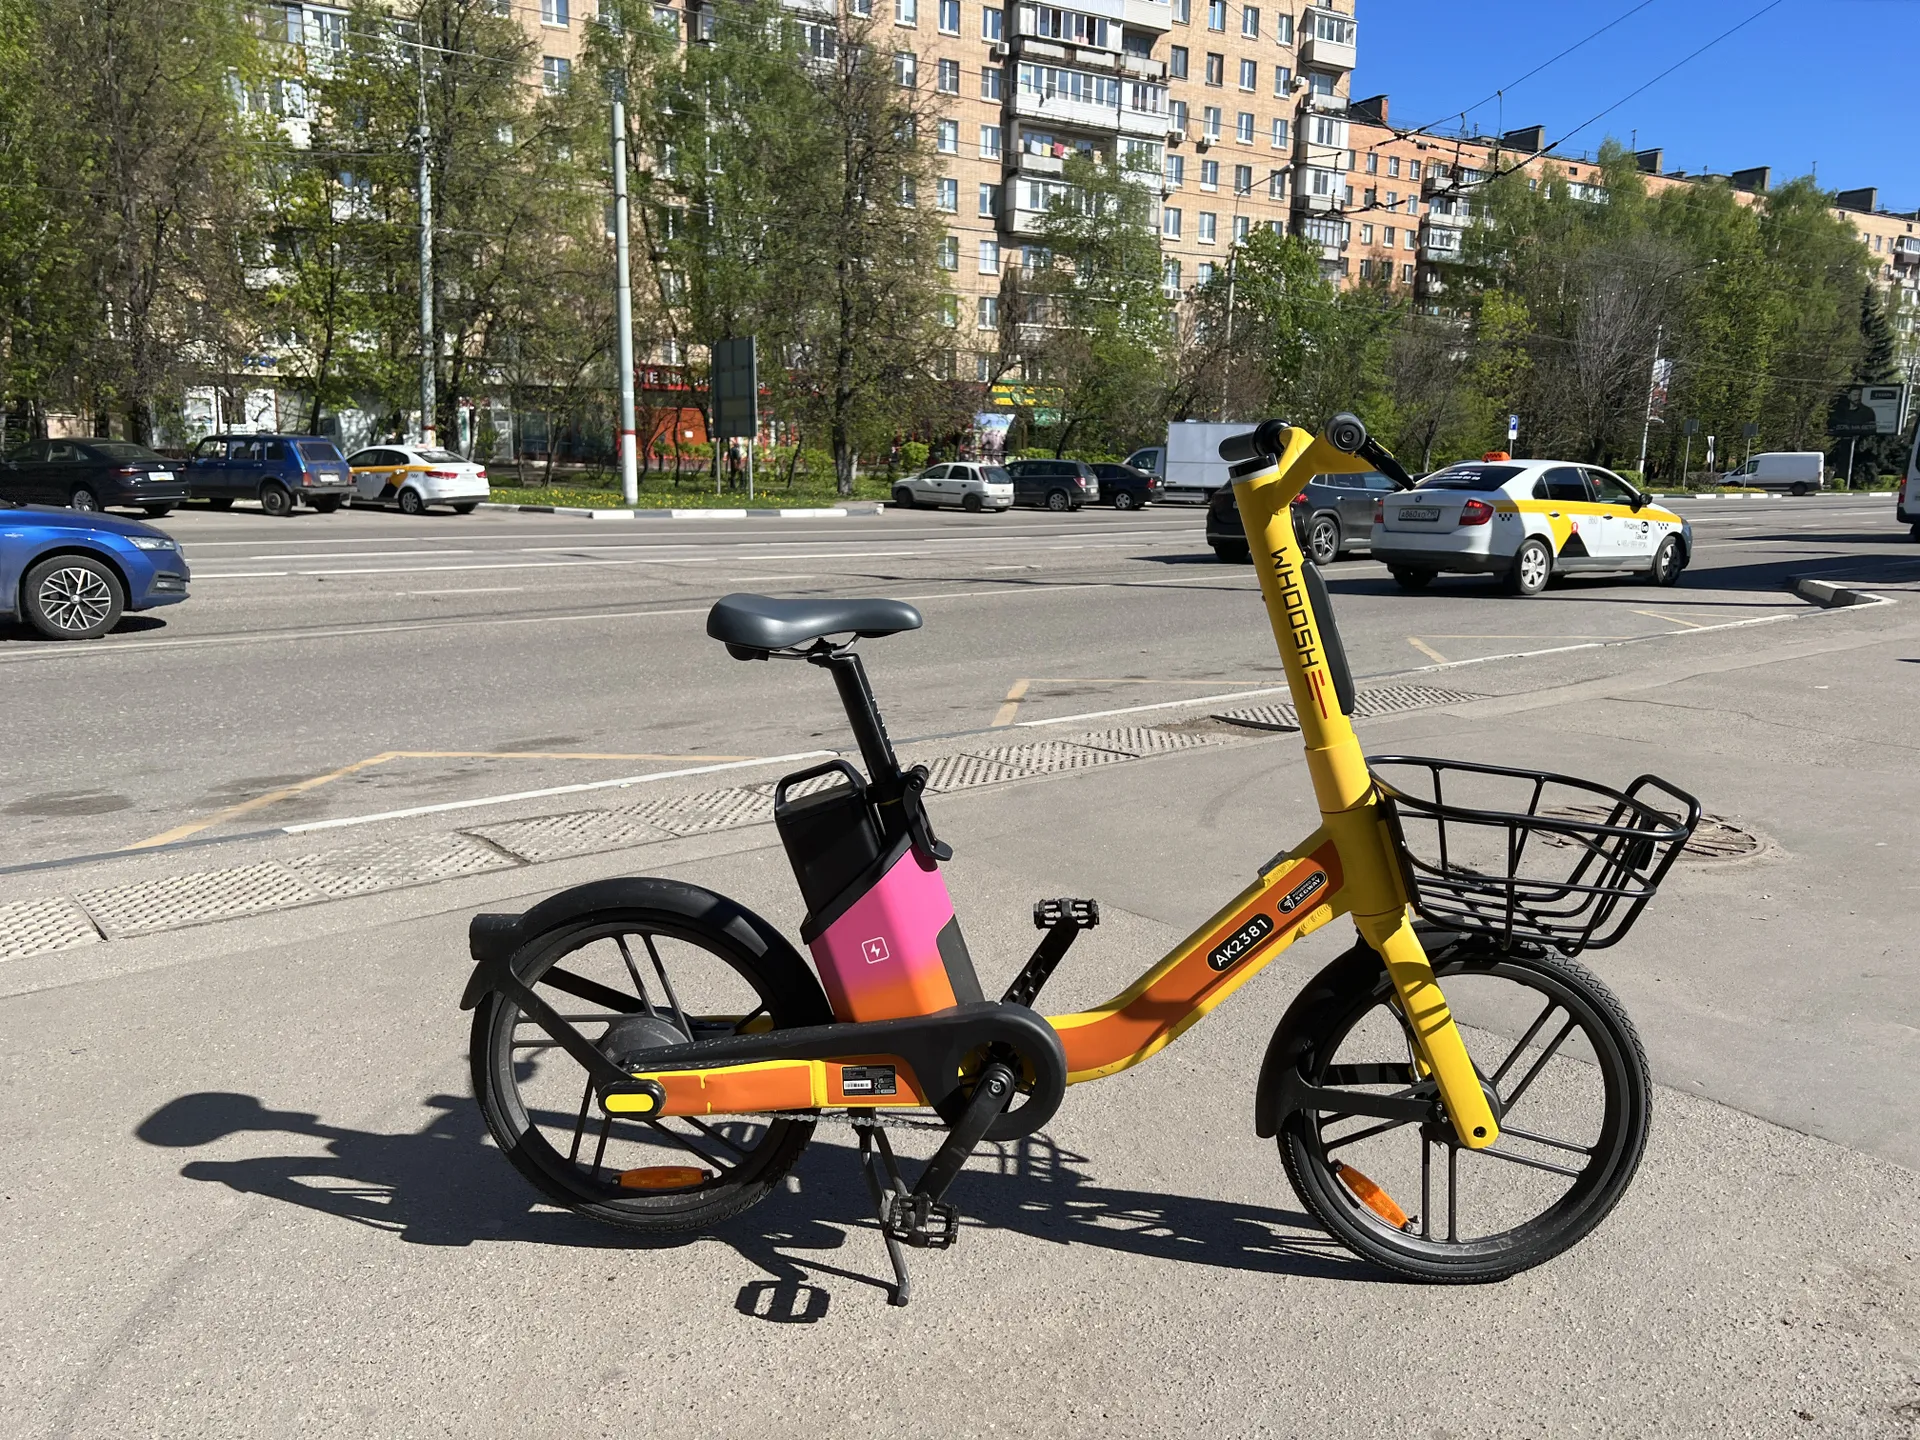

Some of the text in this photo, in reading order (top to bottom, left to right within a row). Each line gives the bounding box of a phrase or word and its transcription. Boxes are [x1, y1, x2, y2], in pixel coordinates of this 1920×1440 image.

[1271, 547, 1319, 668] WHOOSH
[1295, 878, 1320, 900] SEGWAY
[1216, 919, 1268, 966] AK2381
